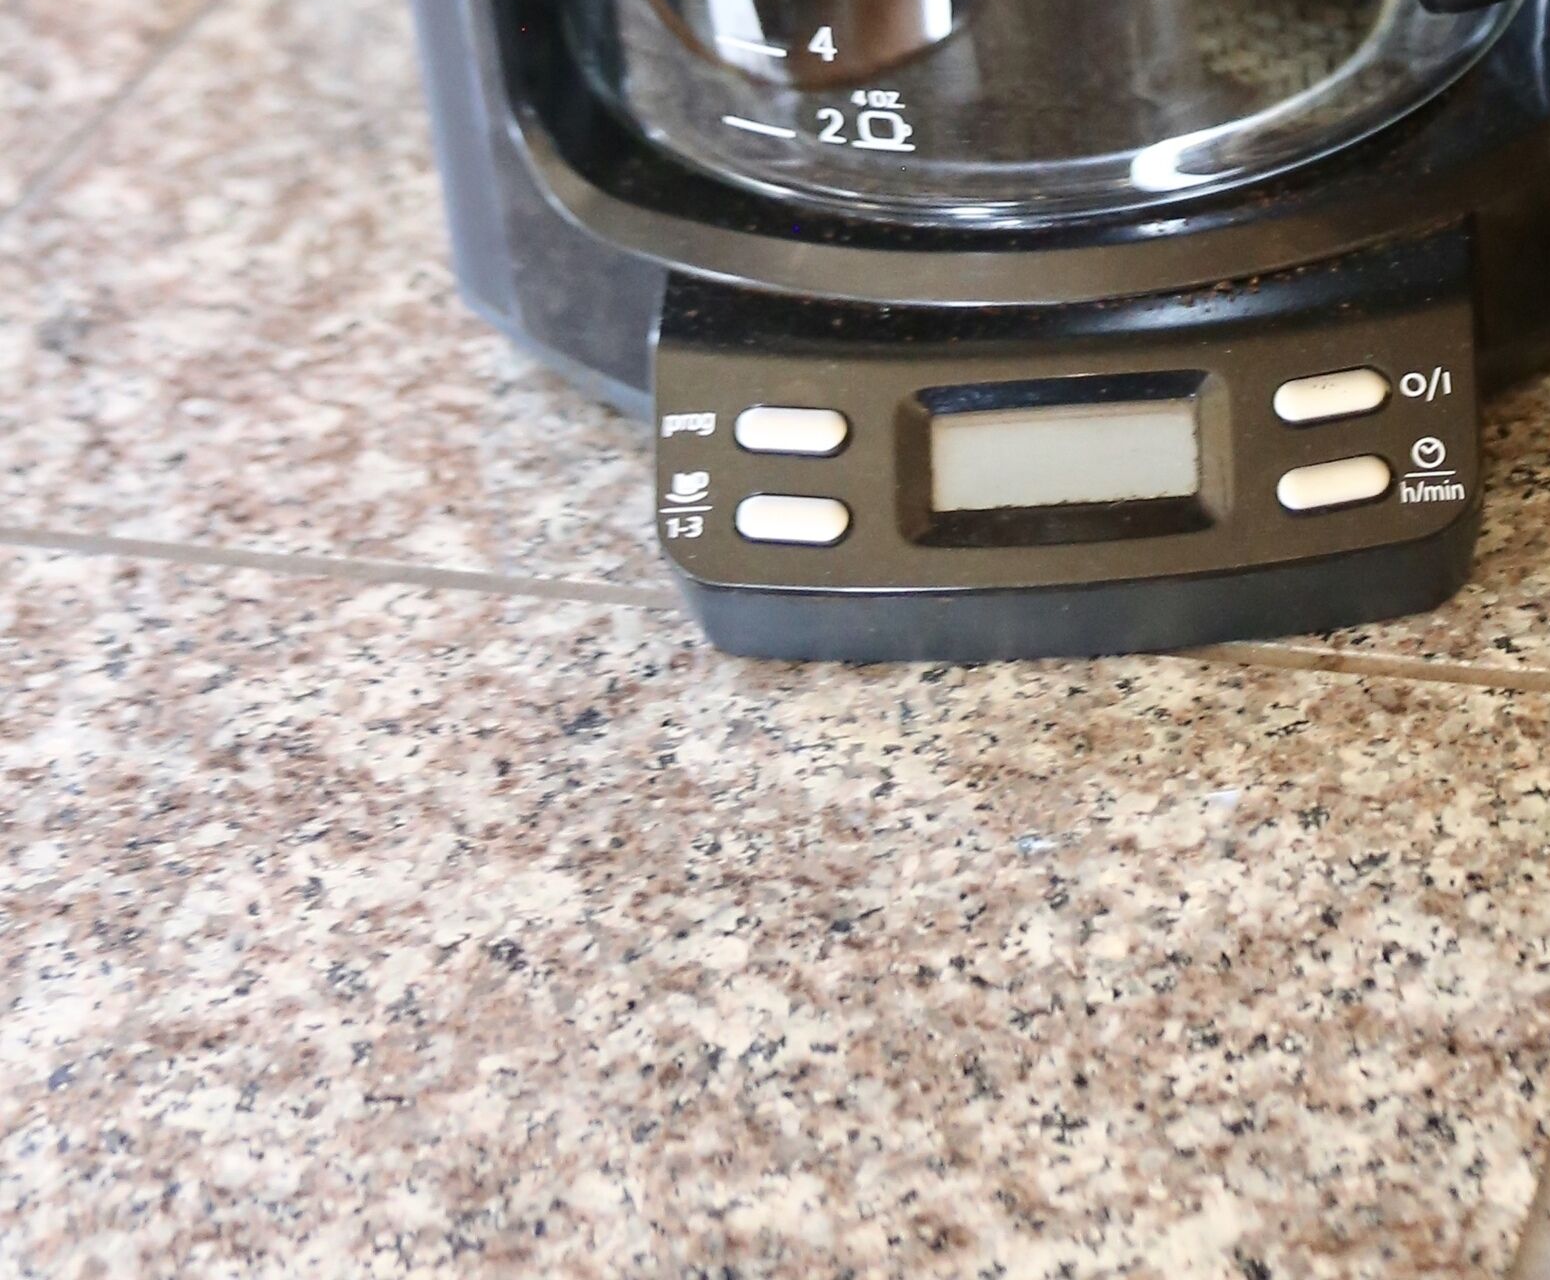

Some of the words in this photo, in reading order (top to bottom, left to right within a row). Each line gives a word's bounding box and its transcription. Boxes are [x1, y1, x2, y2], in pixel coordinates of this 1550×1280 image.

[808, 26, 837, 62] 4
[816, 108, 848, 144] 2
[661, 412, 716, 437] prog
[1399, 479, 1465, 503] h/min
[665, 515, 703, 538] 1-3
